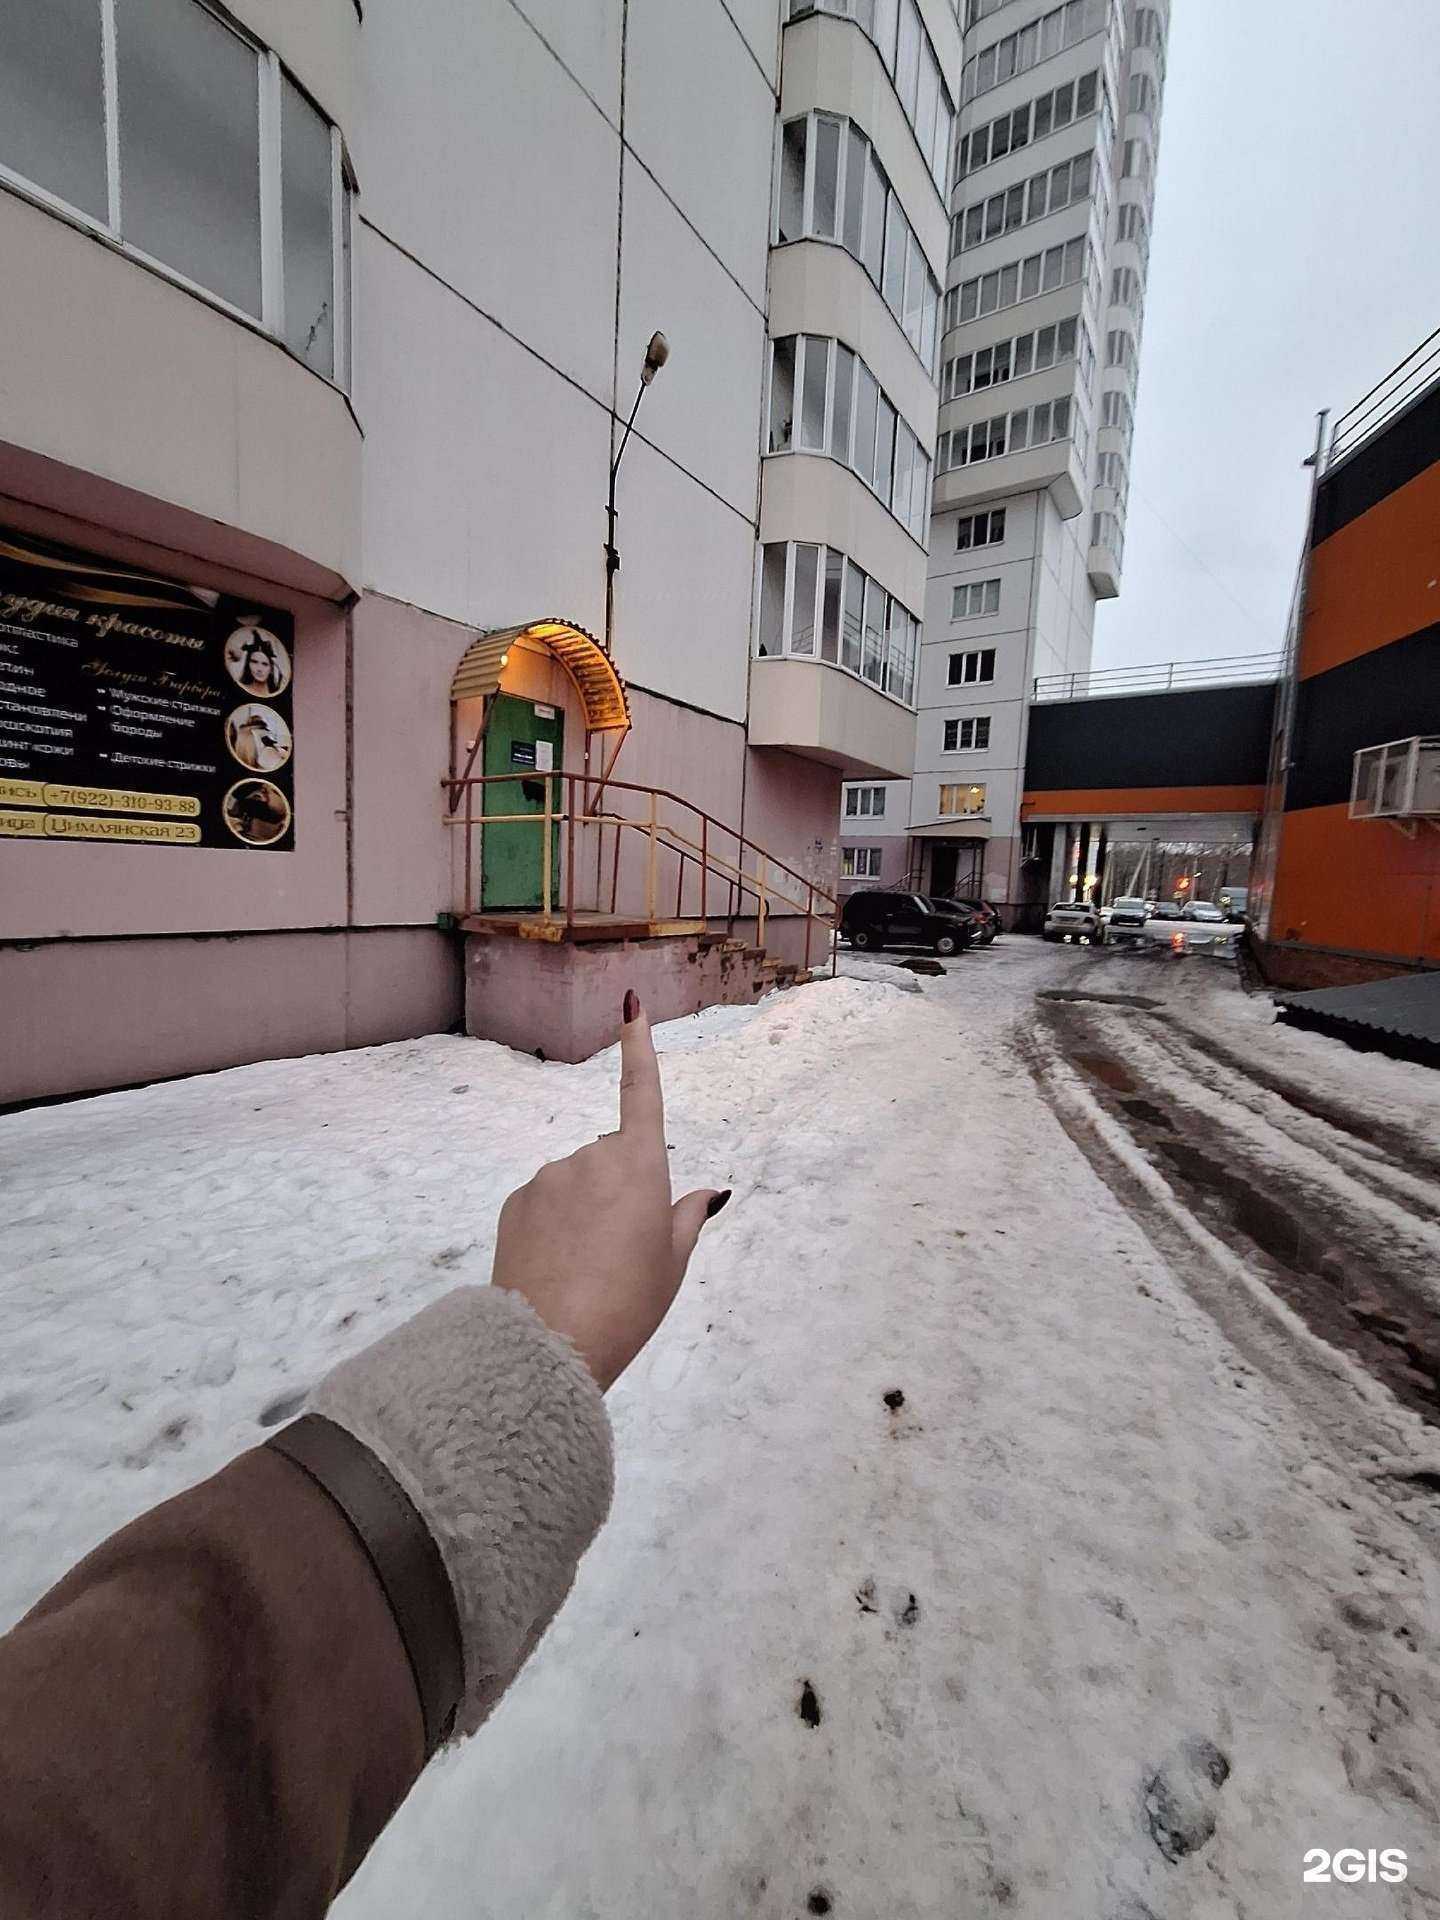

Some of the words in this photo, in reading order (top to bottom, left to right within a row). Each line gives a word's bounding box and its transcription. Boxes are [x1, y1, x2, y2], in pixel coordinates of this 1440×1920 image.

[0, 593, 80, 622] удия
[84, 612, 206, 651] красоты
[109, 687, 169, 706] Мужские
[171, 700, 221, 717] стрижки
[110, 704, 196, 728] Оформление
[111, 721, 163, 739] бороды
[111, 752, 166, 769] Детские
[167, 760, 217, 774] стрижки
[49, 789, 196, 814] +7(922)-310-93-88
[51, 817, 170, 838] Цимлянская
[174, 826, 196, 839] 23
